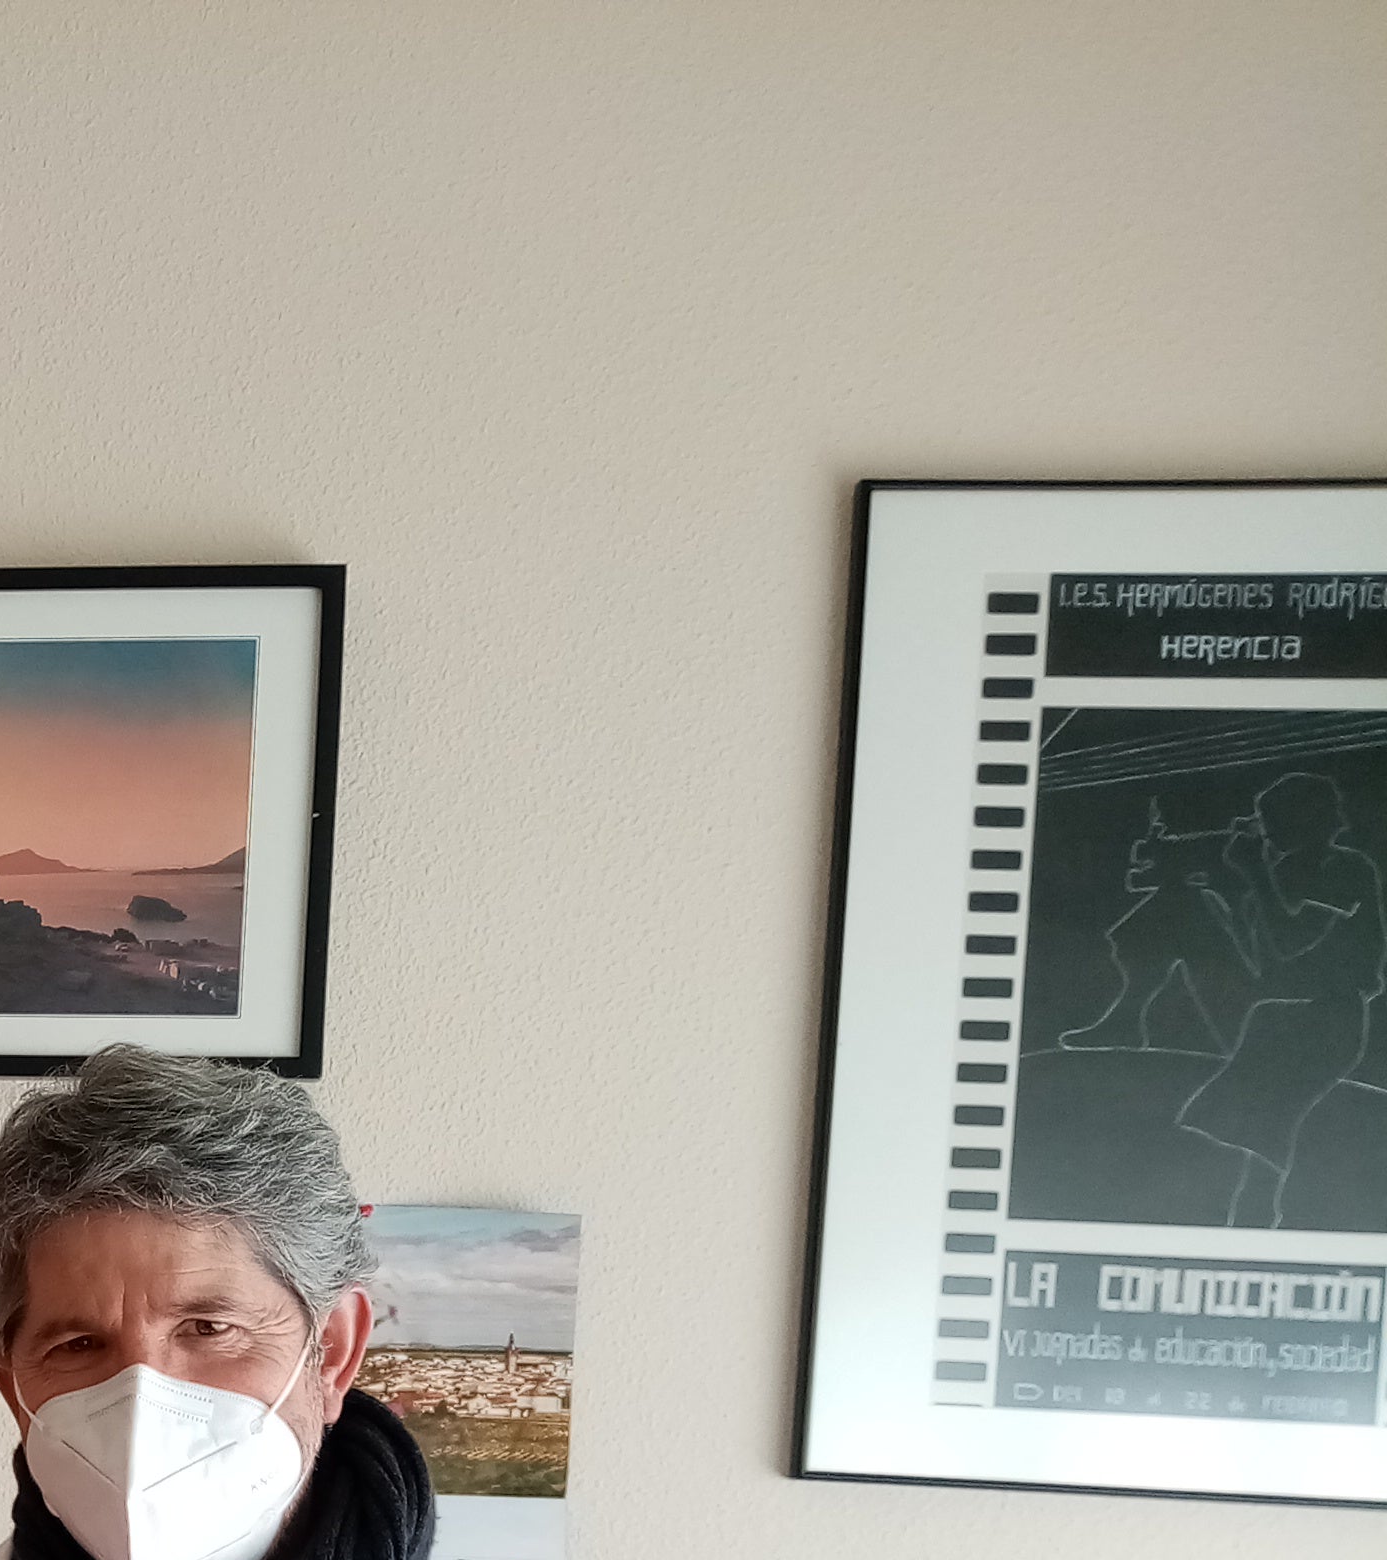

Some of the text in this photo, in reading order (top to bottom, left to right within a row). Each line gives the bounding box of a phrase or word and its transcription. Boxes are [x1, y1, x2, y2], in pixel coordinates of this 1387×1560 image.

[1285, 577, 1387, 621] RODRÍG
[1006, 1261, 1382, 1323] LA COMUNICACIÓN
[1032, 1321, 1123, 1366] Jornadas
[1278, 1333, 1376, 1374] sociedad
